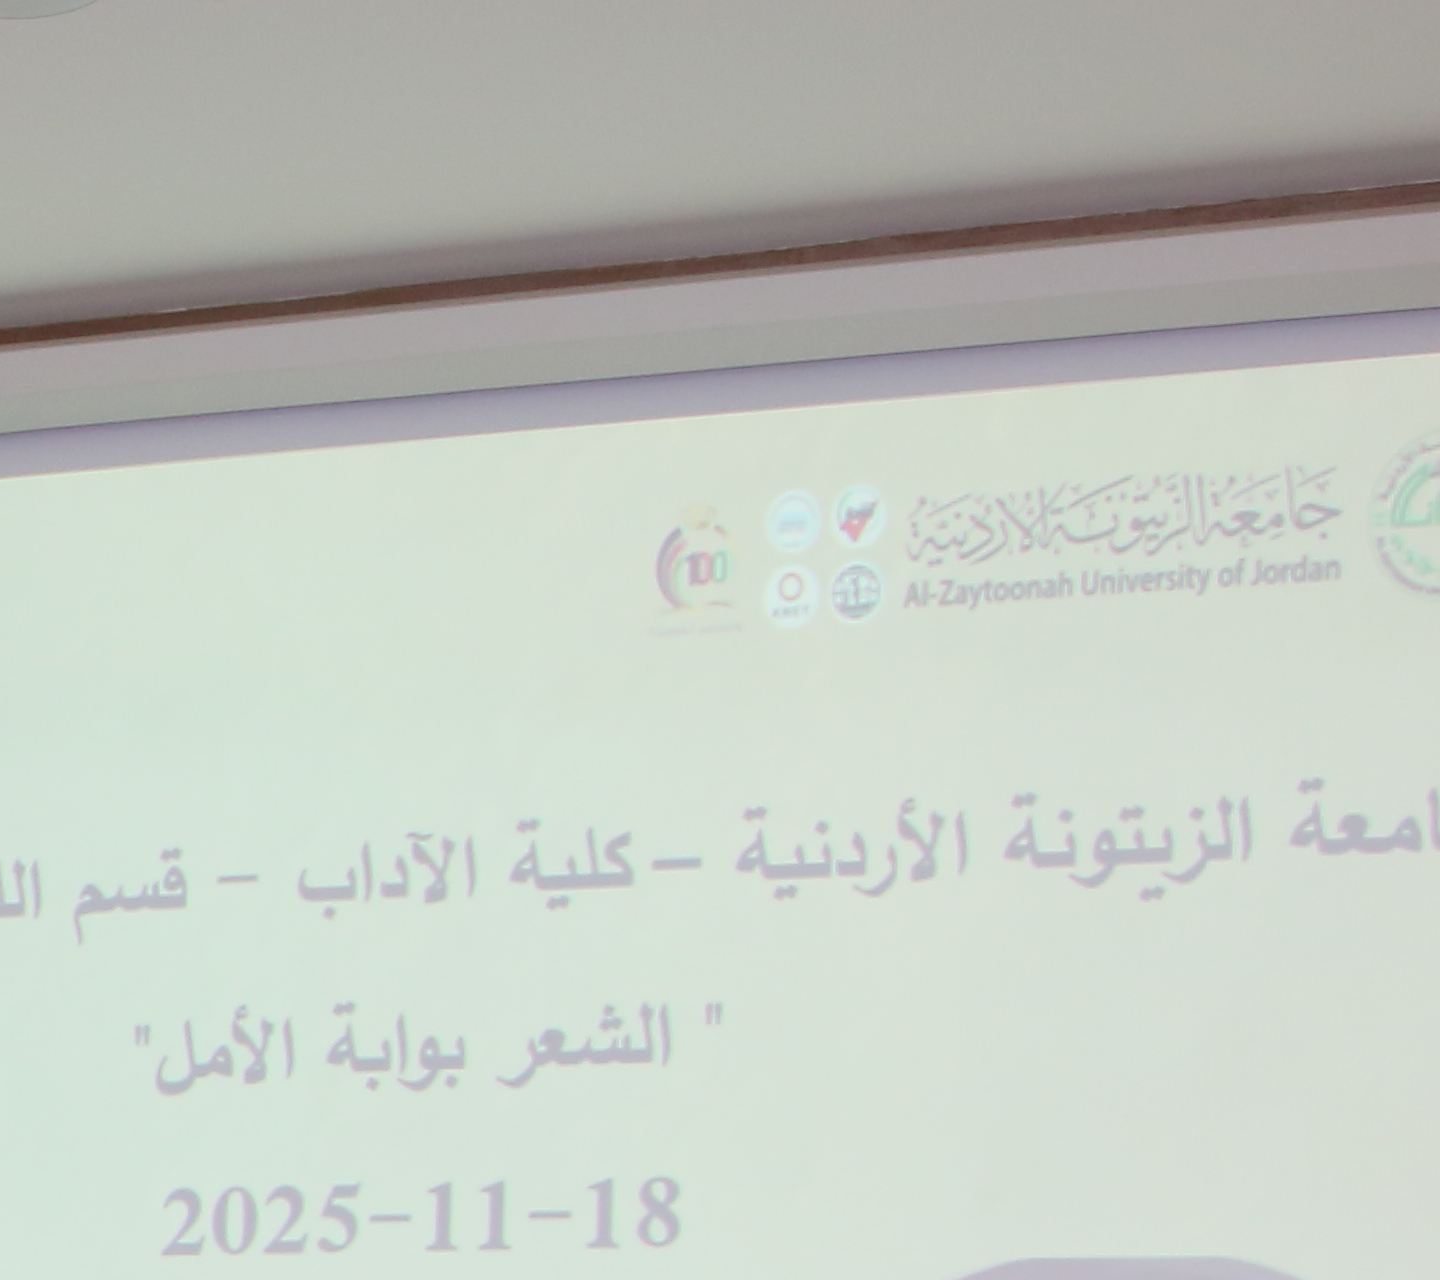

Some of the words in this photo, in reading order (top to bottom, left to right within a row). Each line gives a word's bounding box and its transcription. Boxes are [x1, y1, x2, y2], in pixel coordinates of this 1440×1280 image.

[903, 569, 1074, 611] Al-Zaytoonah
[1081, 563, 1210, 596] University
[1218, 557, 1245, 586] of
[1250, 554, 1342, 586] Jordan
[296, 831, 477, 920] الآداب
[734, 796, 969, 902] الأردنية
[1002, 791, 1254, 902] الزيتونة
[71, 847, 190, 944] قسم
[325, 1001, 467, 1092] بوابة
[496, 1001, 672, 1090] الشعر
[160, 1175, 682, 1258] 2025-11-18
